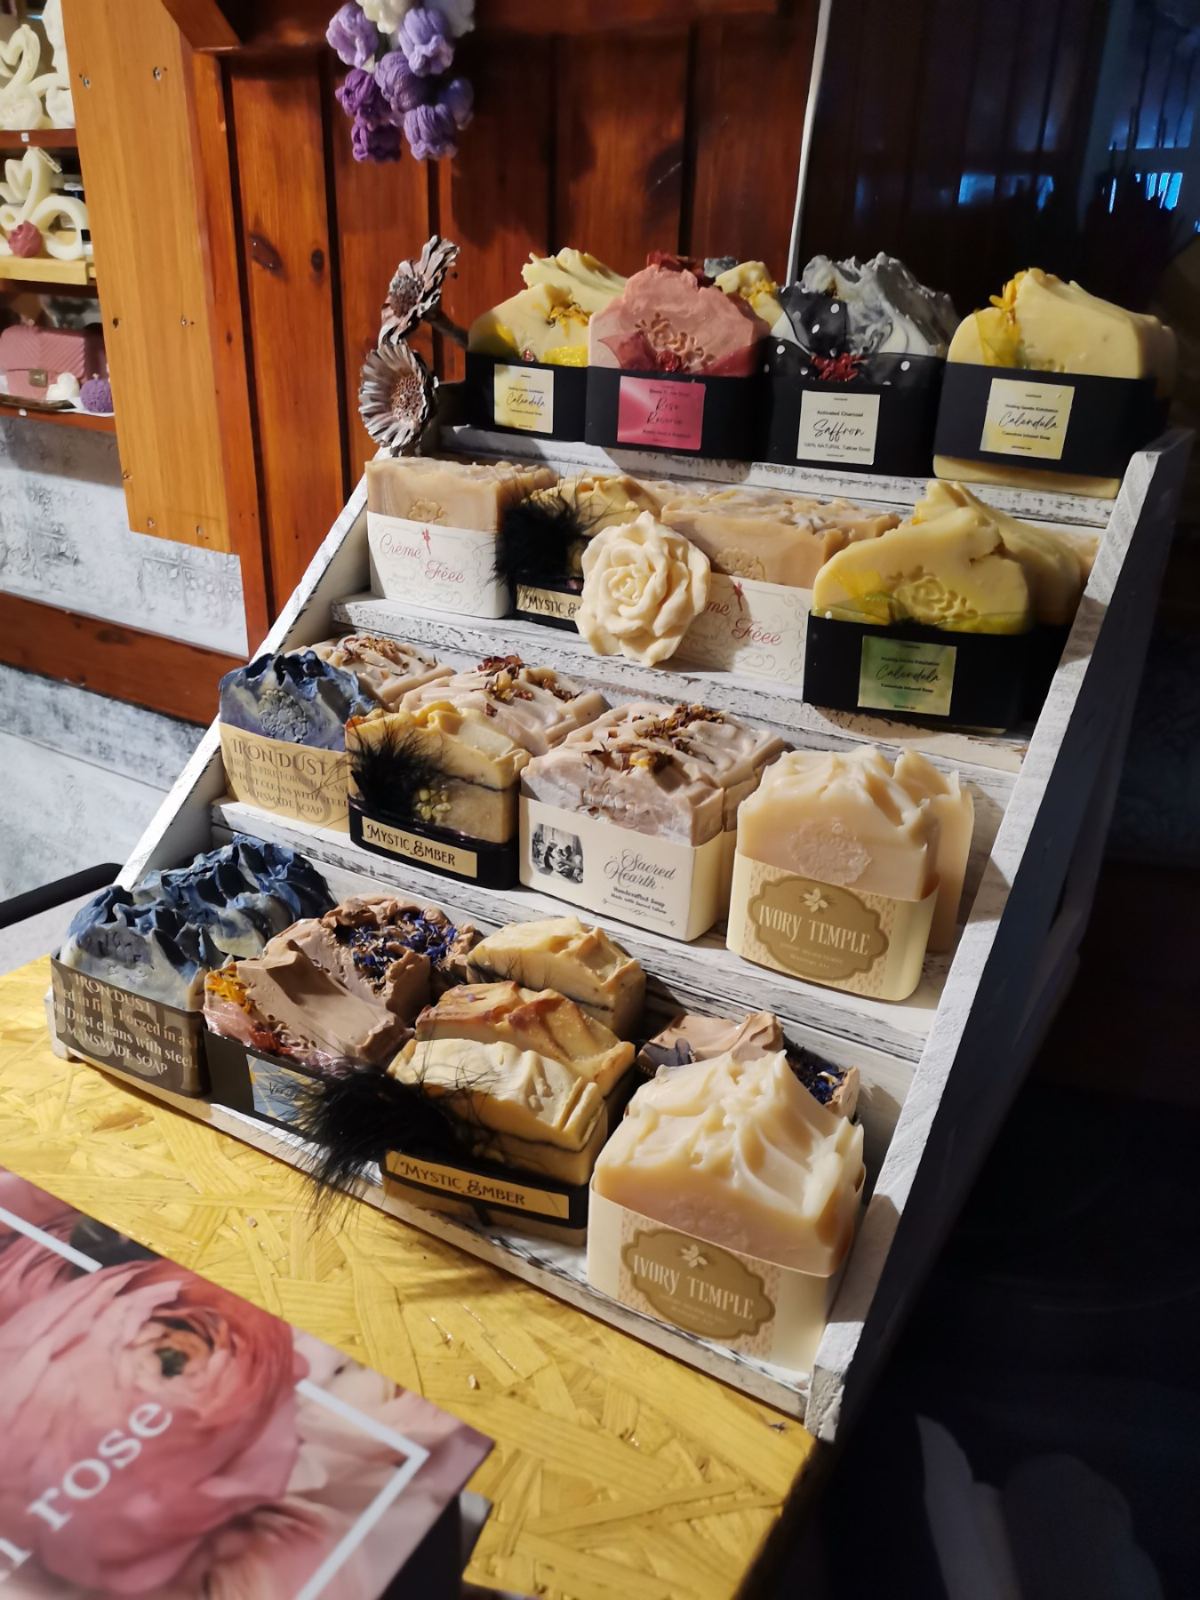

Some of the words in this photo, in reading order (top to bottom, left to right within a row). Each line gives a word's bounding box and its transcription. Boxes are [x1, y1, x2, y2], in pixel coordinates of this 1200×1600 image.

[813, 418, 865, 442] Saffron
[998, 411, 1058, 430] Calendula
[875, 664, 941, 683] Calendula
[279, 753, 328, 776] DUST
[367, 824, 411, 851] MYSTIC
[603, 860, 657, 889] Hearth
[621, 849, 676, 879] Sacred
[758, 905, 802, 942] IVORY
[808, 919, 871, 956] TEMPLE
[74, 971, 111, 998] IRON
[112, 989, 150, 1014] DUST
[66, 1006, 94, 1029] Dust
[136, 1036, 162, 1056] with
[164, 1025, 176, 1043] in
[136, 1052, 168, 1075] SOAP
[400, 1160, 461, 1189] MYSTIC
[633, 1253, 680, 1295] IVORY
[687, 1276, 755, 1320] TEMPLE
[26, 1402, 174, 1532] rose
